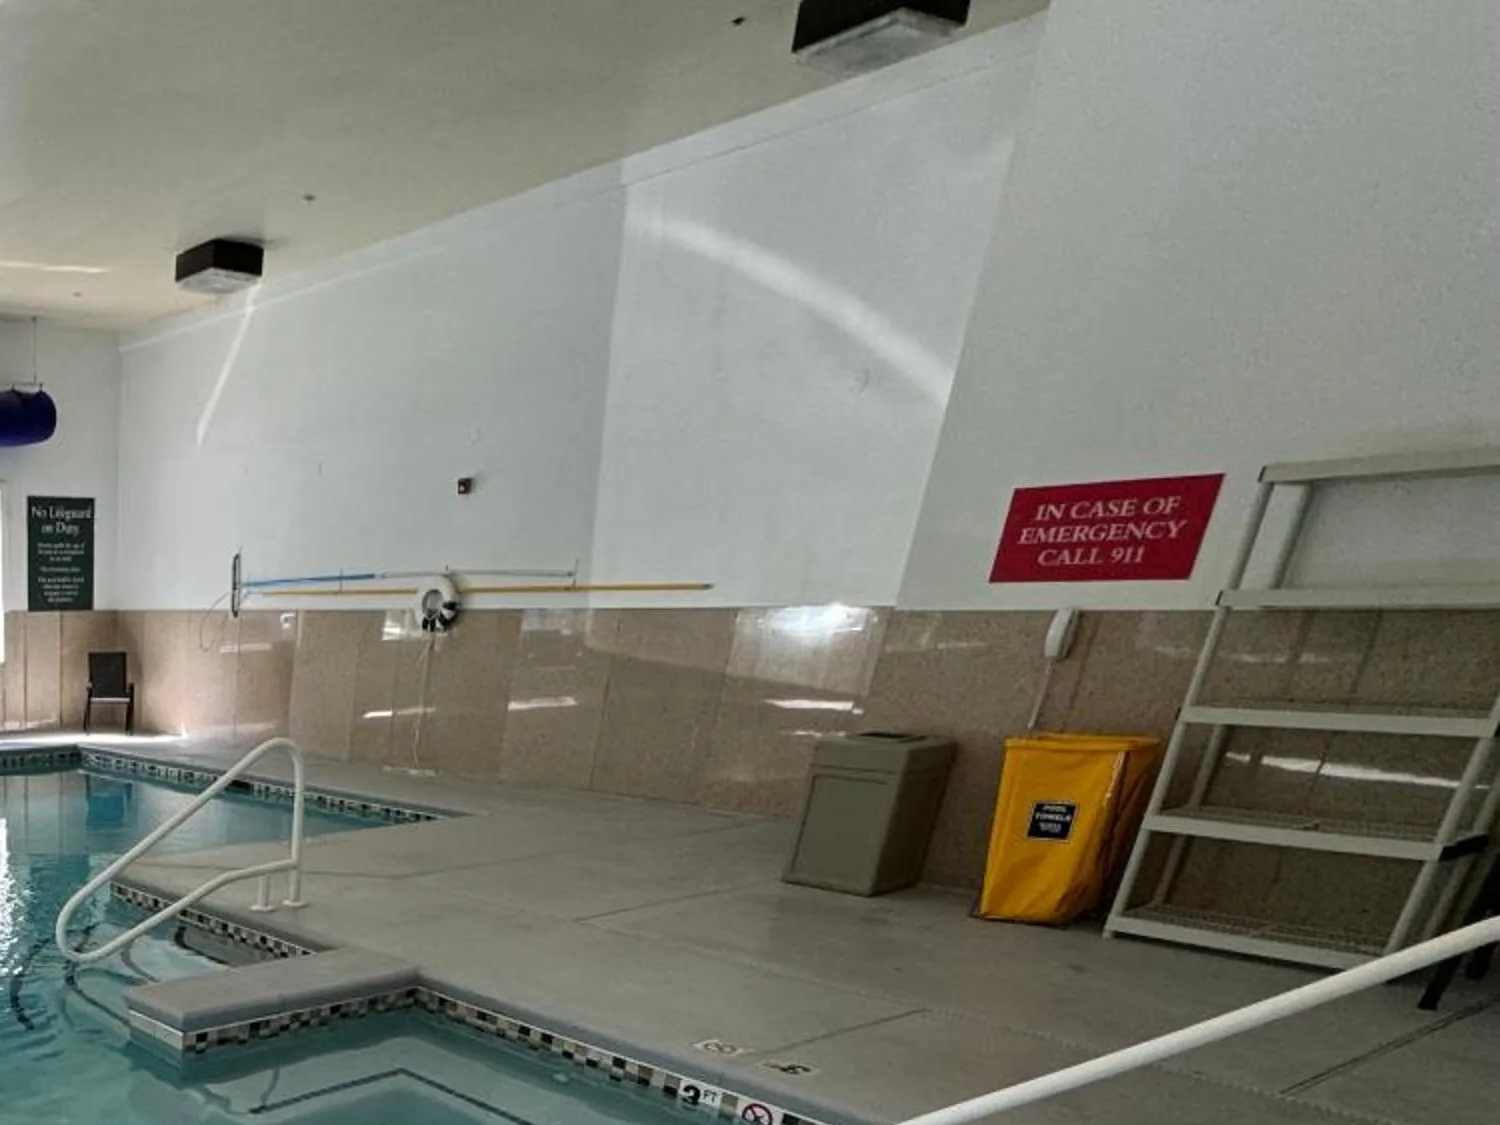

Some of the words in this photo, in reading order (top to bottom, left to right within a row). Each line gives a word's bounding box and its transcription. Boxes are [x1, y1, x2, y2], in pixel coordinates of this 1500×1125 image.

[31, 505, 47, 518] No
[49, 505, 91, 521] Lifeguard
[1035, 503, 1065, 521] IN
[1070, 498, 1137, 519] CASE
[1142, 495, 1182, 516] OF
[1017, 519, 1188, 545] EMERGENCY
[1037, 547, 1104, 566] CALL
[1111, 546, 1146, 564] 911
